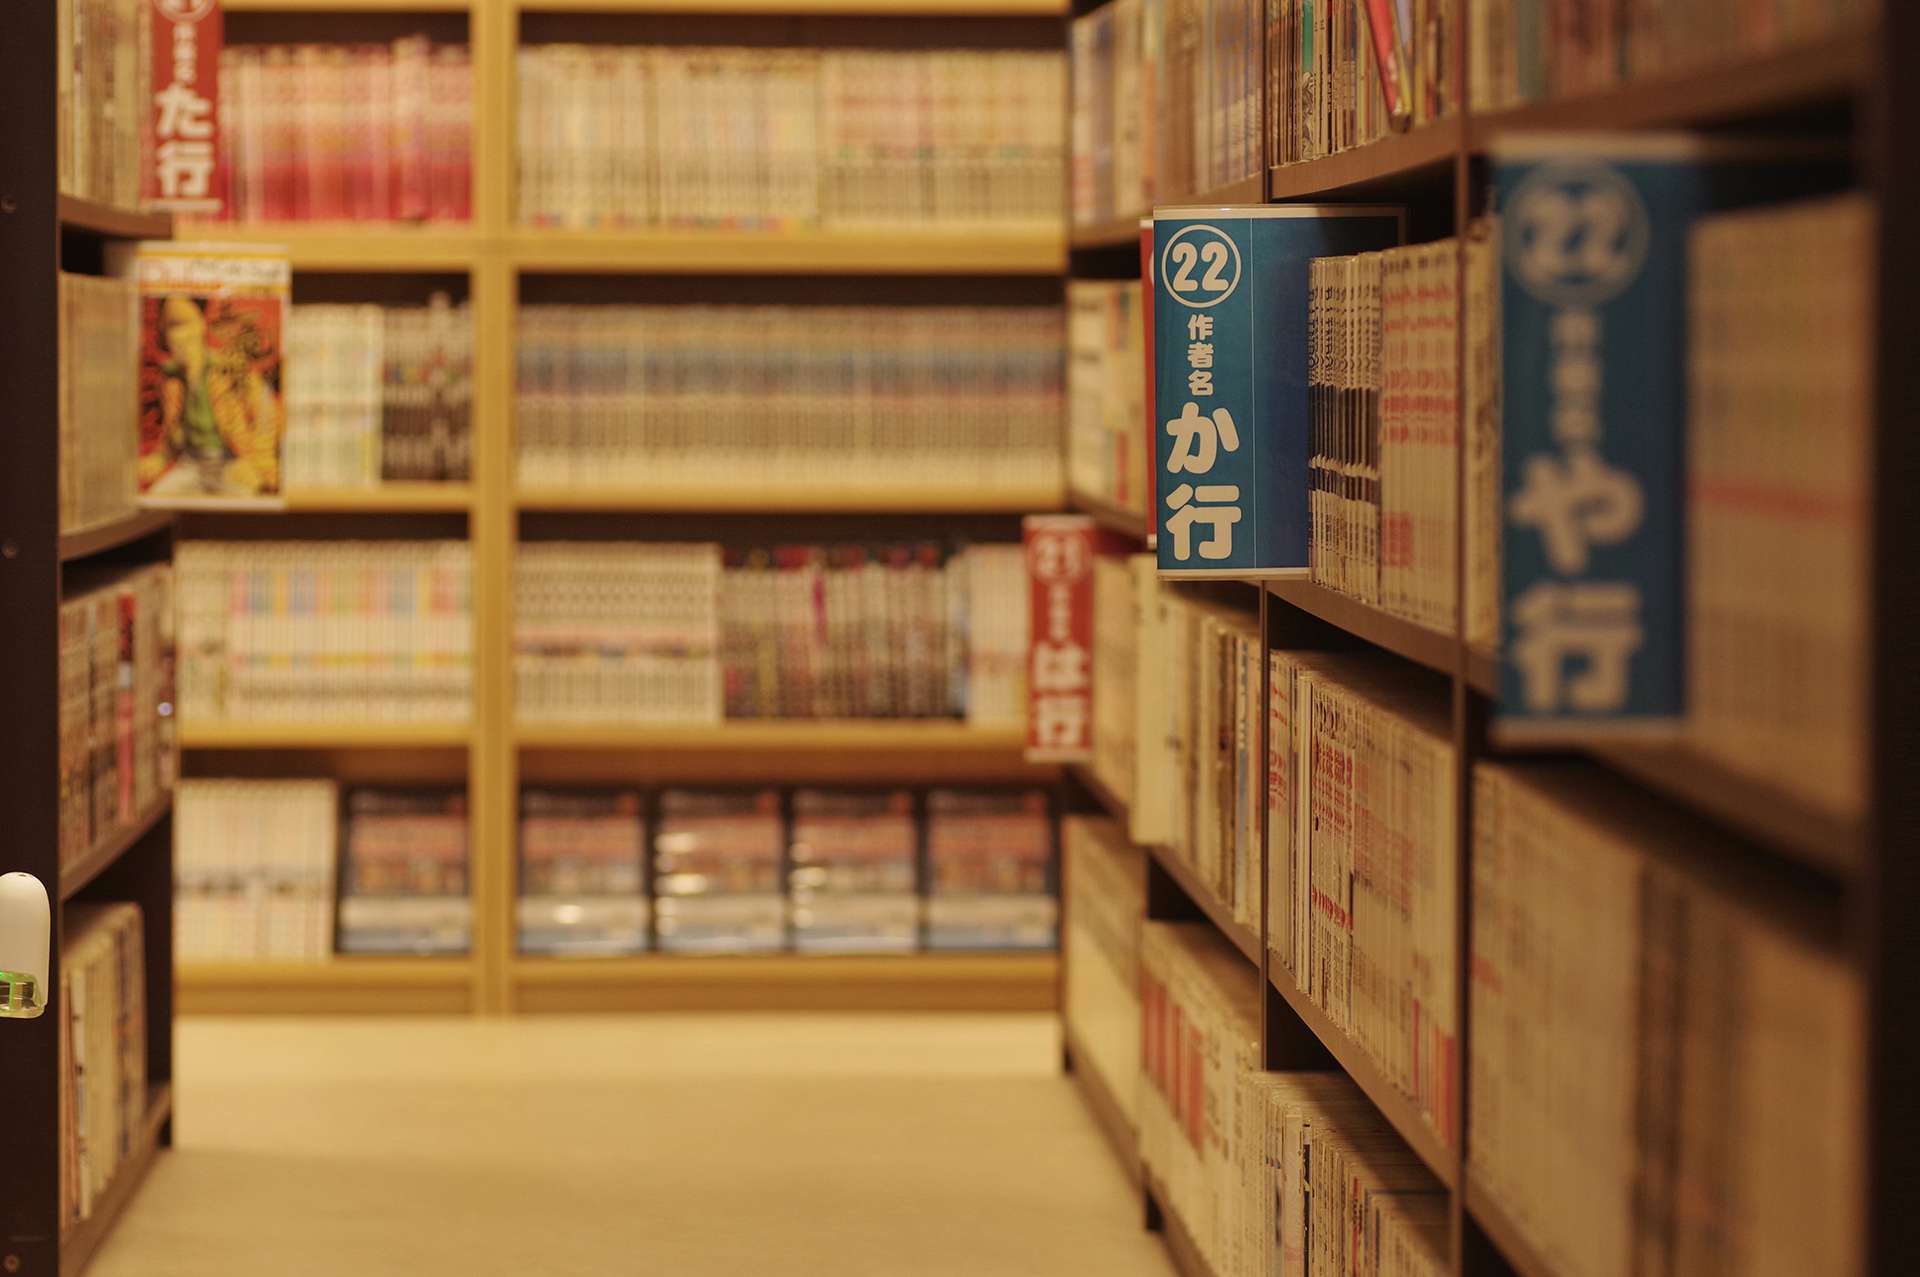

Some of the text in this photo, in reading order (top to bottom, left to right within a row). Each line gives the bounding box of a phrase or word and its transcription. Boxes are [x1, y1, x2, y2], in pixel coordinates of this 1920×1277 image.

[156, 84, 214, 197] た行
[1172, 242, 1229, 291] 22
[1187, 314, 1214, 396] 作者名
[1165, 402, 1241, 561] か行
[1510, 453, 1643, 712] や行
[1035, 641, 1086, 746] は行
